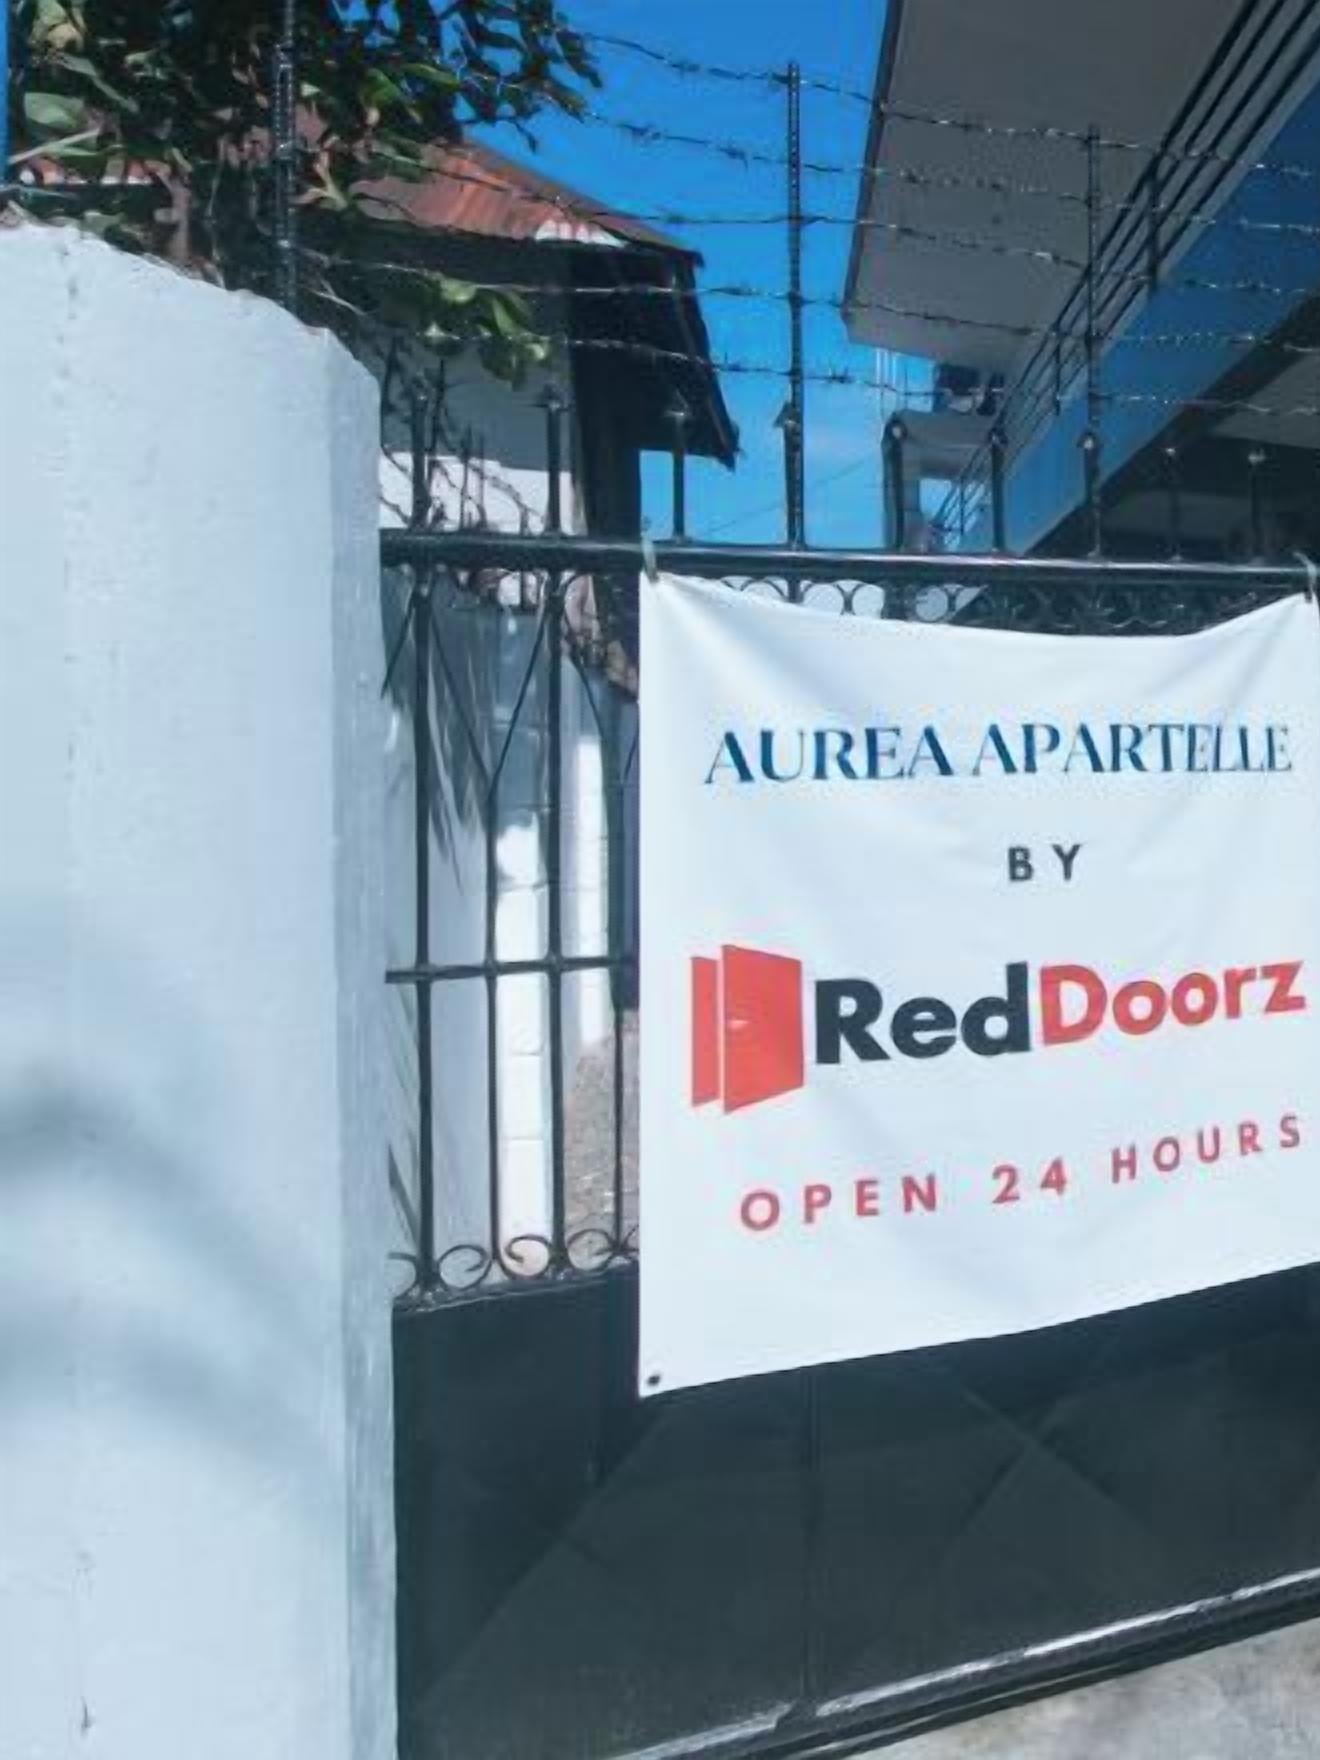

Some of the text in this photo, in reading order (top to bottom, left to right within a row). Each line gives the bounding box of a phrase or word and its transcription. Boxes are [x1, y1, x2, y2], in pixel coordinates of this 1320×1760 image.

[705, 723, 1293, 784] AUREA APARTELLE
[1007, 844, 1083, 882] BY
[814, 961, 1307, 1065] RedDoorz
[740, 1114, 1303, 1231] OPEN 24 HOURS
